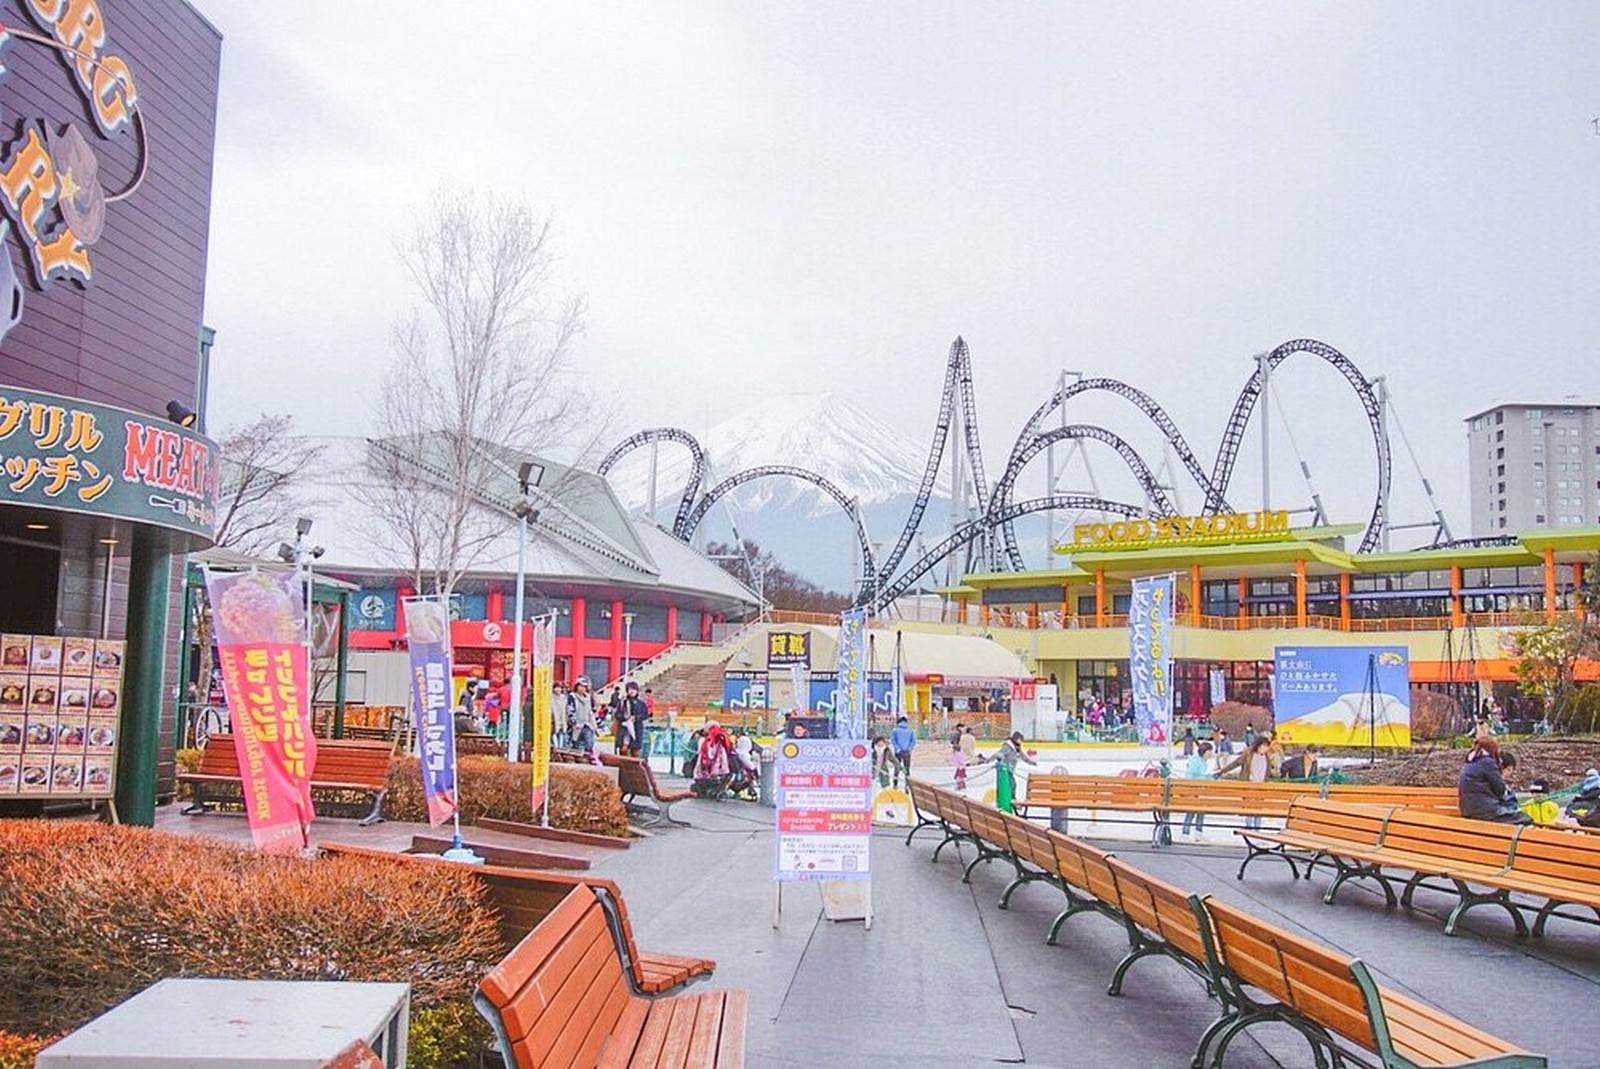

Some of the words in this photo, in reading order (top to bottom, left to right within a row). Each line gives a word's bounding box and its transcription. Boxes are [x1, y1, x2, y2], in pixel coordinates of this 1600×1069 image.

[0, 454, 112, 501] ッチン
[1074, 520, 1149, 544] FOOD
[1156, 511, 1289, 539] STADIUM
